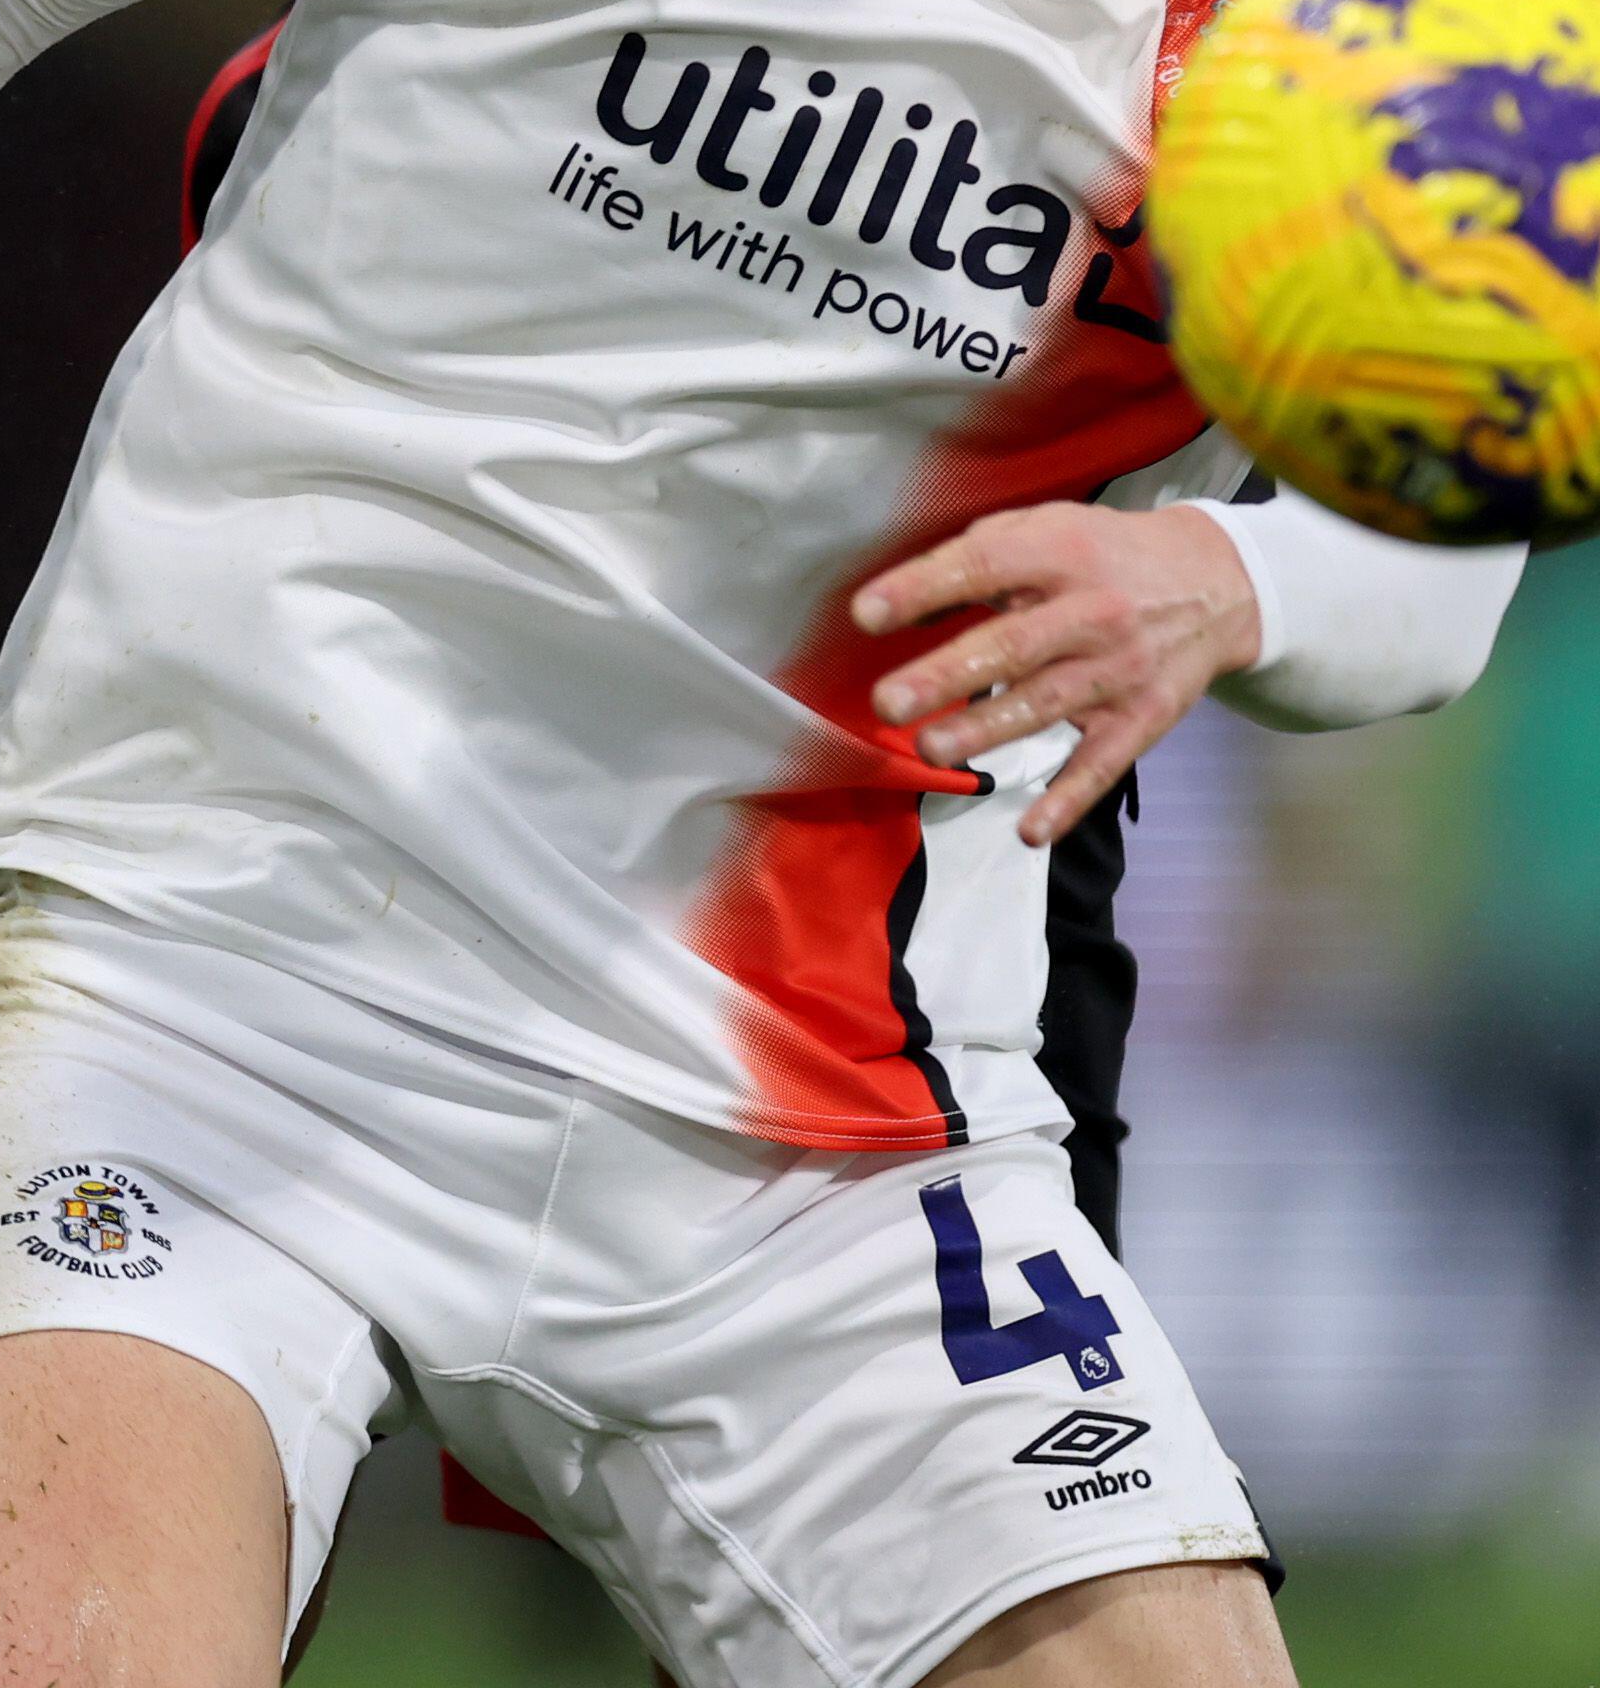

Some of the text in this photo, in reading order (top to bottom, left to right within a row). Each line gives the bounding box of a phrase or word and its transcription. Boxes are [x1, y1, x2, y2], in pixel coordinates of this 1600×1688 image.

[596, 32, 1071, 307] utilita
[549, 142, 1027, 379] life with power
[17, 1164, 159, 1215] LUTON TOWN
[0, 1210, 172, 1252] EST 1885
[17, 1234, 164, 1280] FOOTBALL CLUB
[918, 1173, 1125, 1392] 4
[1044, 1469, 1152, 1511] umbro
